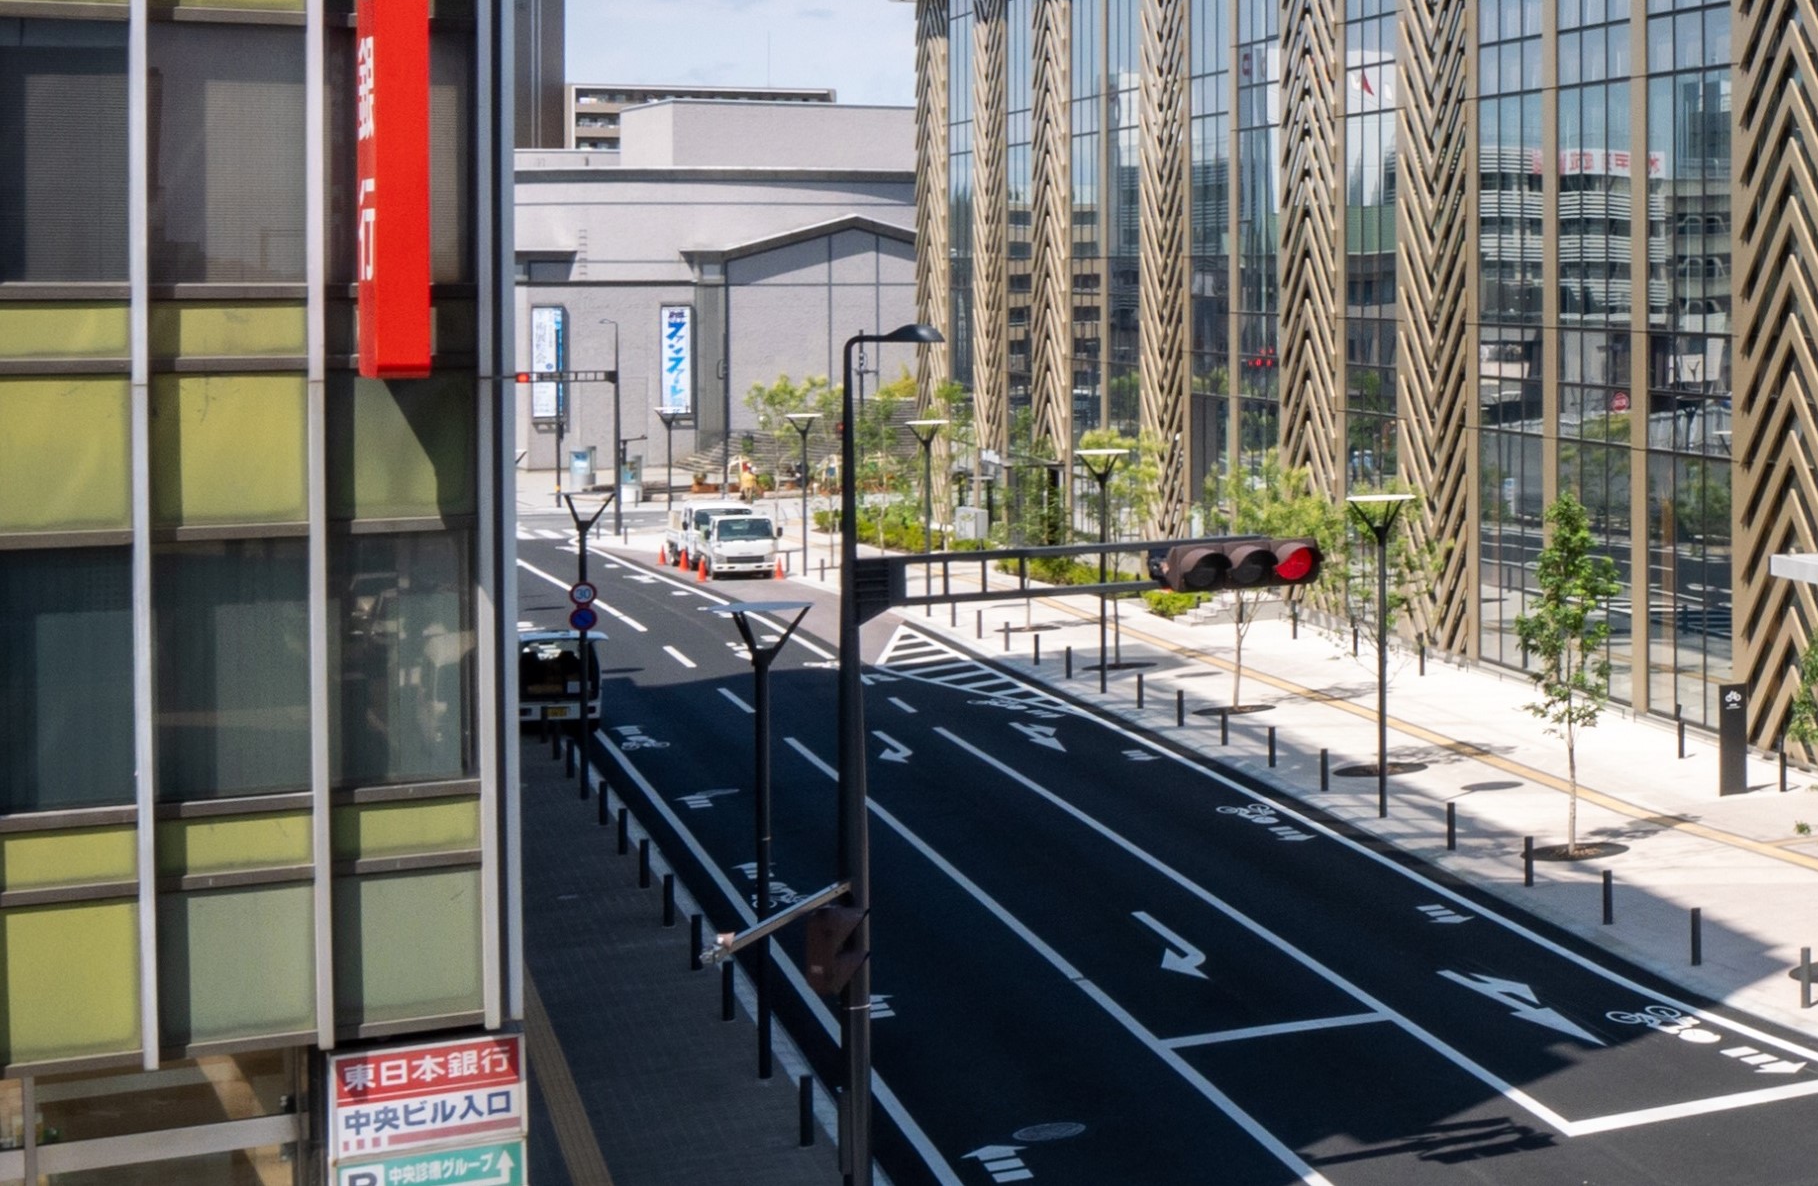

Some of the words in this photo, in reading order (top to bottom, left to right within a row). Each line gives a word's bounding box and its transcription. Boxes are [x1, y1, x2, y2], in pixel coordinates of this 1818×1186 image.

[575, 588, 592, 600] 30
[343, 1045, 510, 1092] 東日本銀行
[344, 1090, 512, 1136] 中央ビル入口
